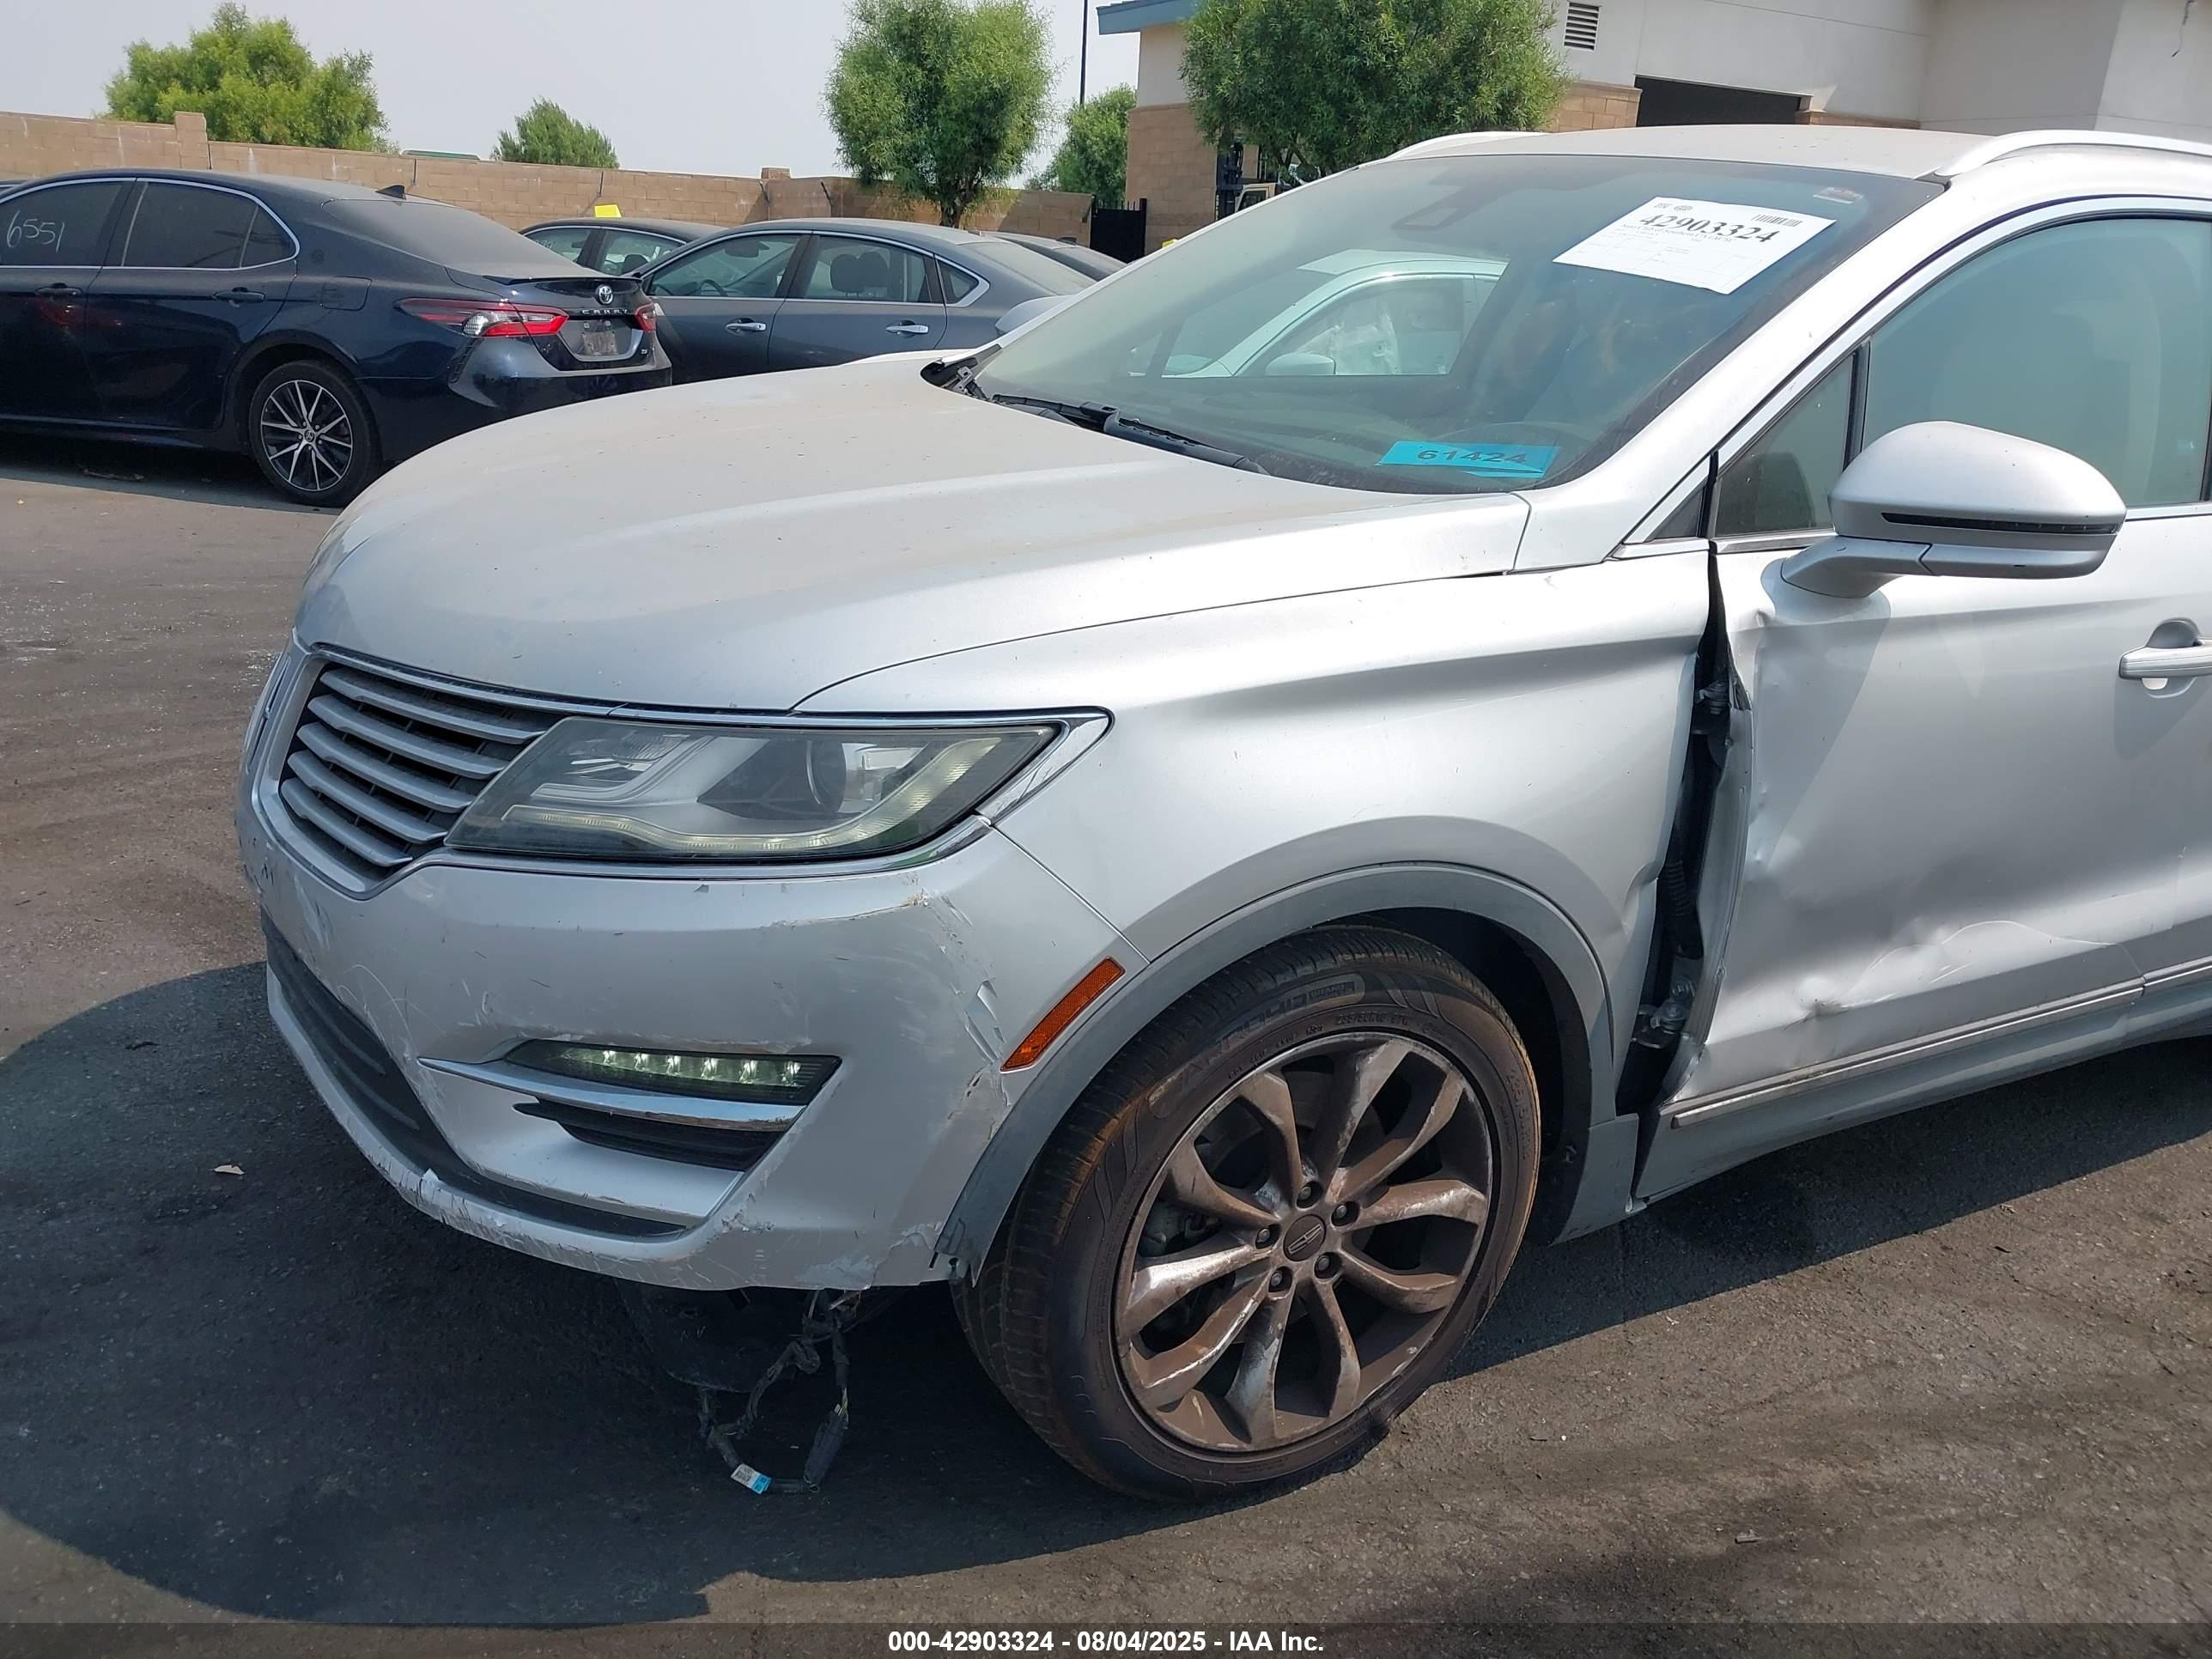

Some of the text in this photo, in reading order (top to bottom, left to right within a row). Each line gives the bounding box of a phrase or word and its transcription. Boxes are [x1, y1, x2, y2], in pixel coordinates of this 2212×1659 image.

[7, 210, 65, 252] 6551
[1639, 214, 1781, 242] 42903324
[1418, 450, 1526, 464] 61424
